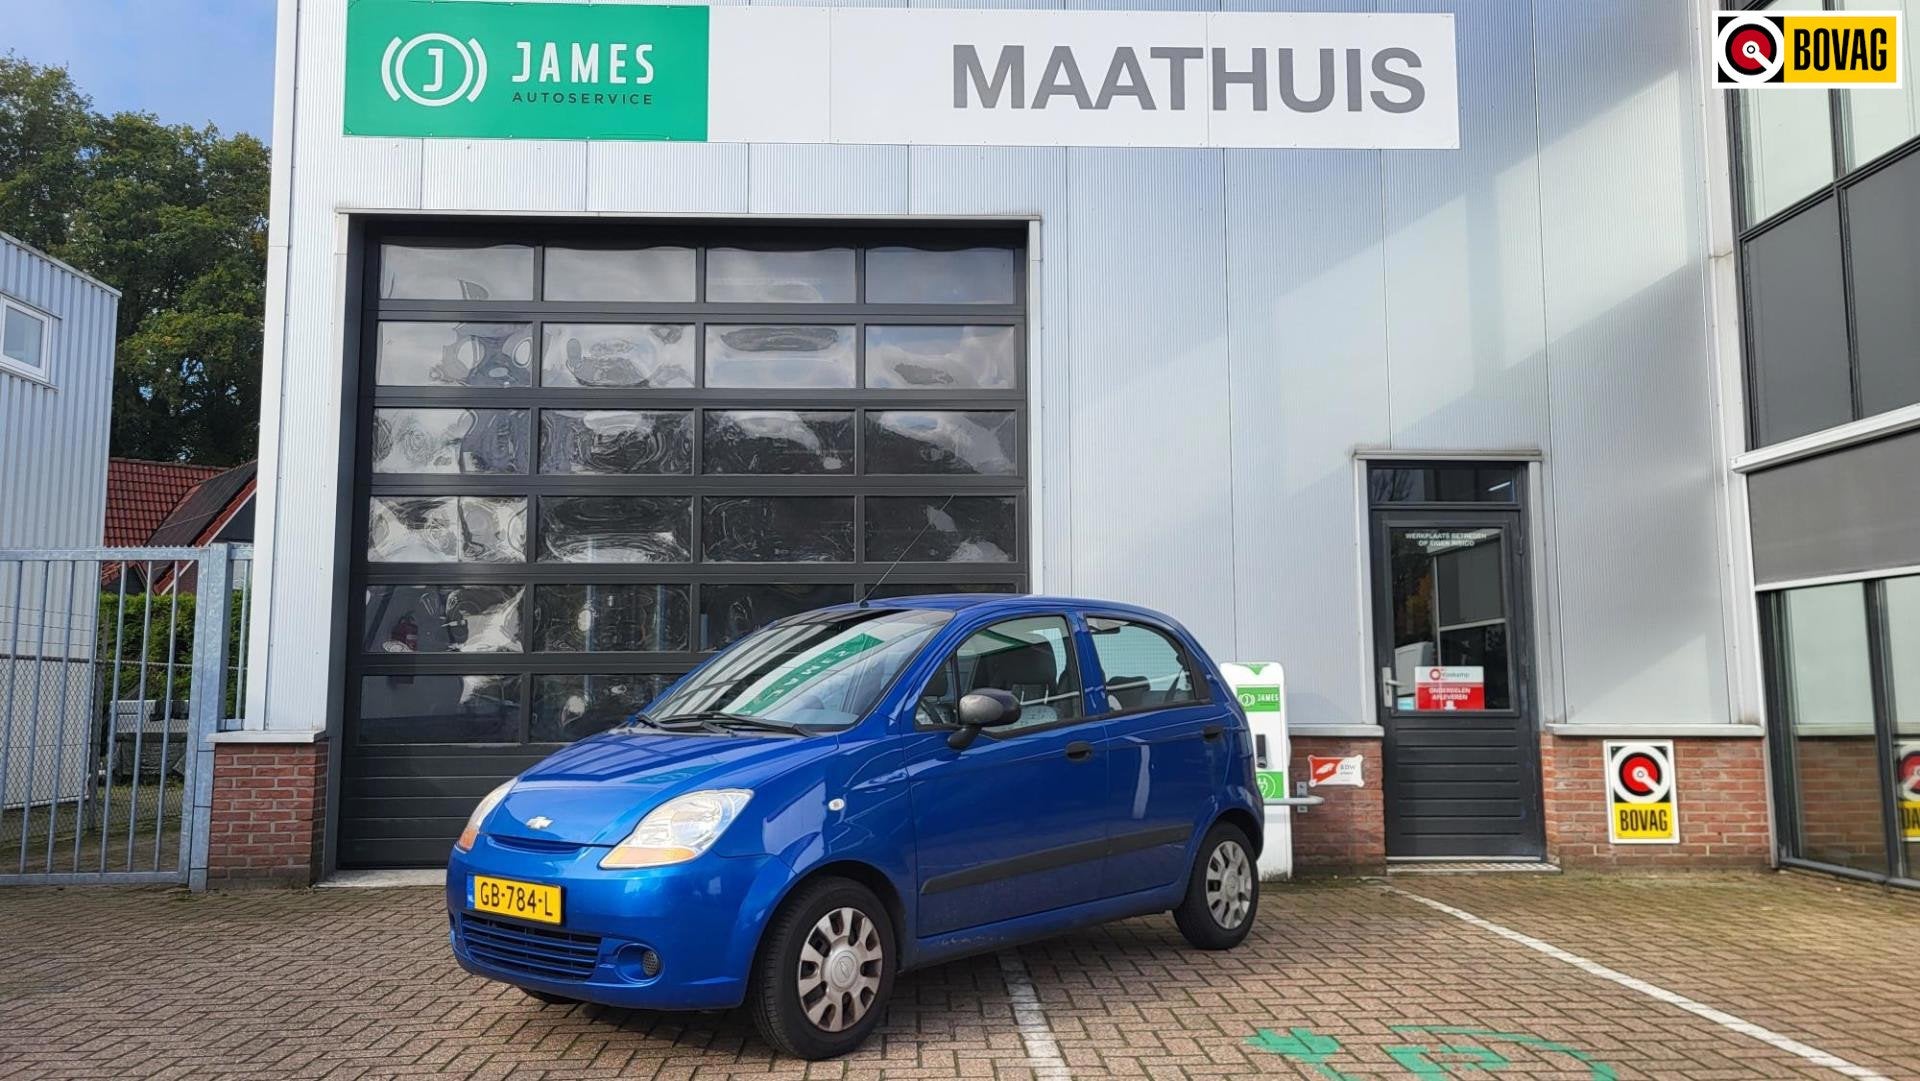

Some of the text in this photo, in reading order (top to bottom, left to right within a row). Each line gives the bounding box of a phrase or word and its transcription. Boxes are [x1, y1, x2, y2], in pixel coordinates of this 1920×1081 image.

[512, 41, 655, 85] JAMES
[953, 44, 1426, 114] MAATHUIS
[512, 91, 653, 105] AUTOSERVICE
[1405, 532, 1449, 540] WERKPLAATS
[1257, 693, 1280, 702] JAMES
[1619, 809, 1668, 831] BOVAG
[480, 881, 553, 916] GB-784-L
